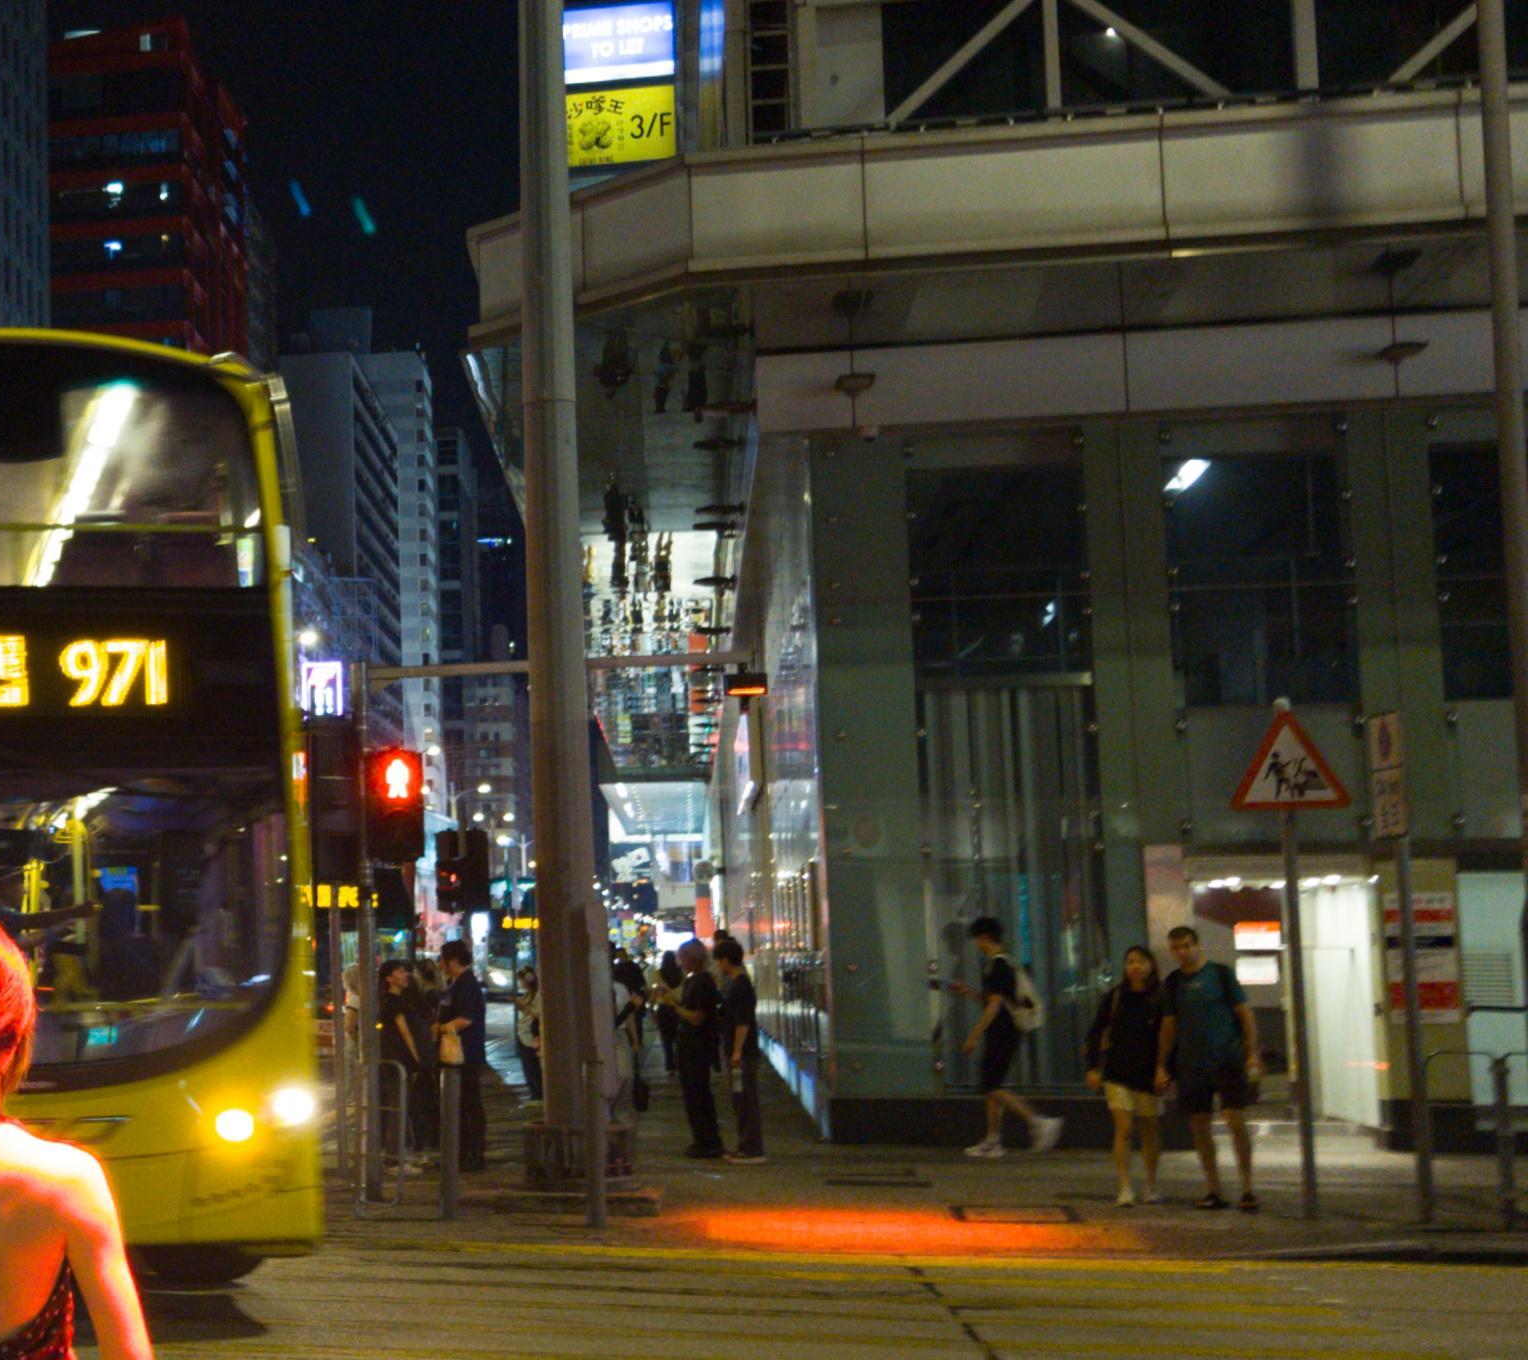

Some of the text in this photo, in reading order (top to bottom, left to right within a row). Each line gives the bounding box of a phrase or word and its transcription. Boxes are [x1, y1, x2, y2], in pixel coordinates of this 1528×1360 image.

[563, 14, 673, 39] PRIME SHOPS
[590, 37, 645, 58] TO LET
[630, 112, 672, 139] 3/F
[59, 639, 168, 707] 971
